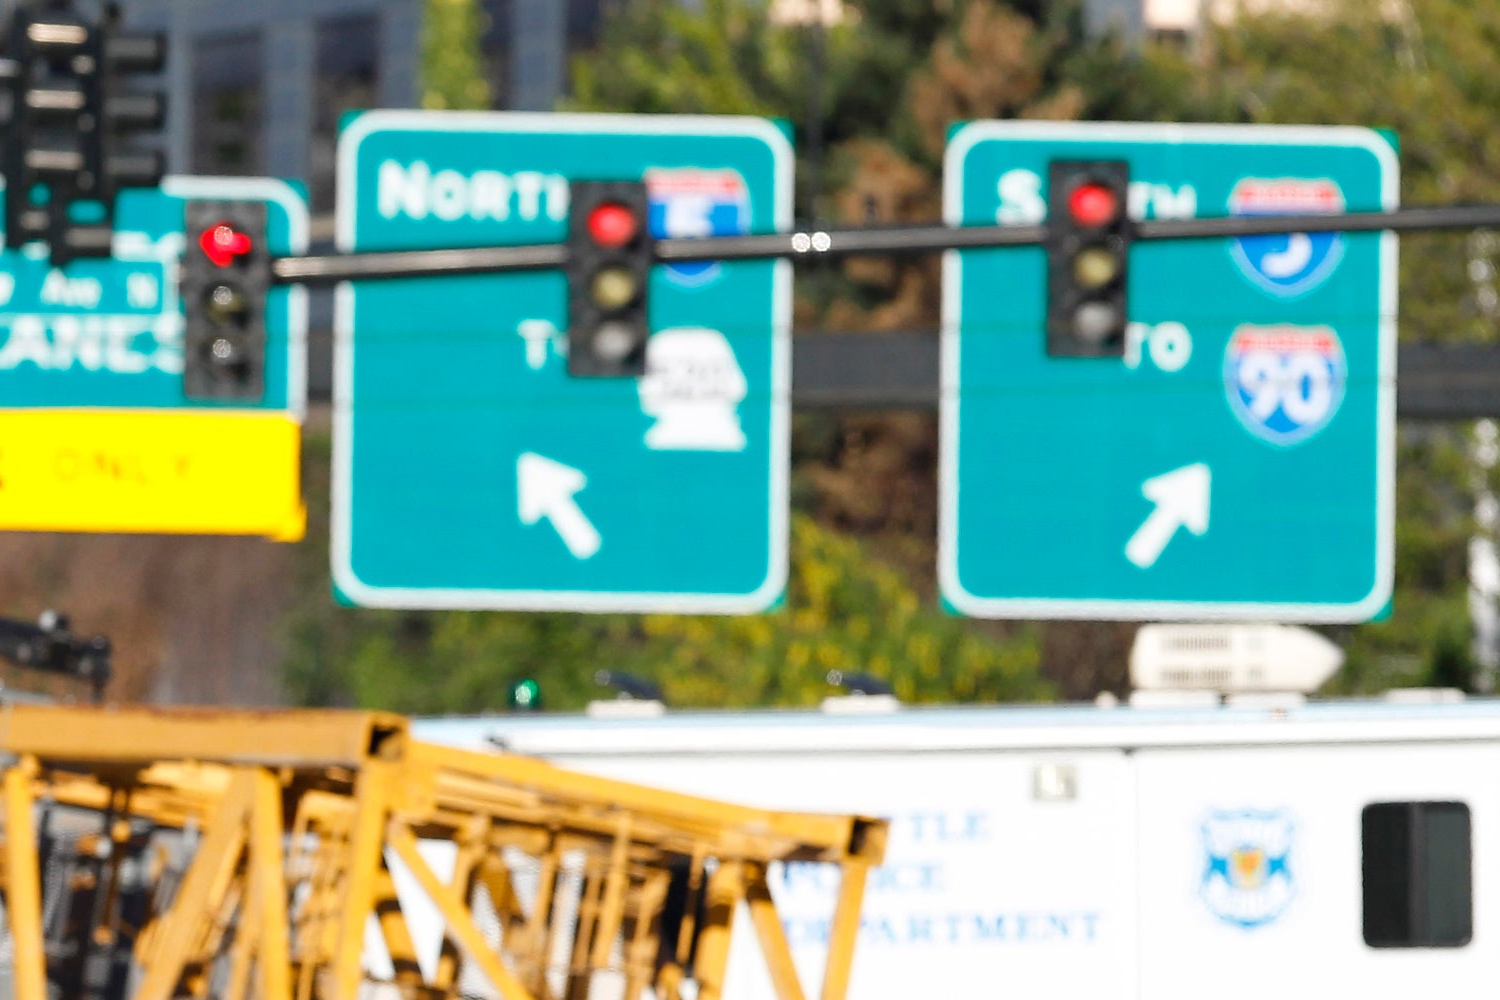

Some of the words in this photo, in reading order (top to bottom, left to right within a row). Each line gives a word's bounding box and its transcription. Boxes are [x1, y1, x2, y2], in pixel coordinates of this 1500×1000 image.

[996, 169, 1197, 225] STH
[40, 268, 102, 309] Ave
[127, 271, 159, 308] N
[1238, 350, 1332, 424] 90
[782, 911, 1099, 943] DEARTMENT
